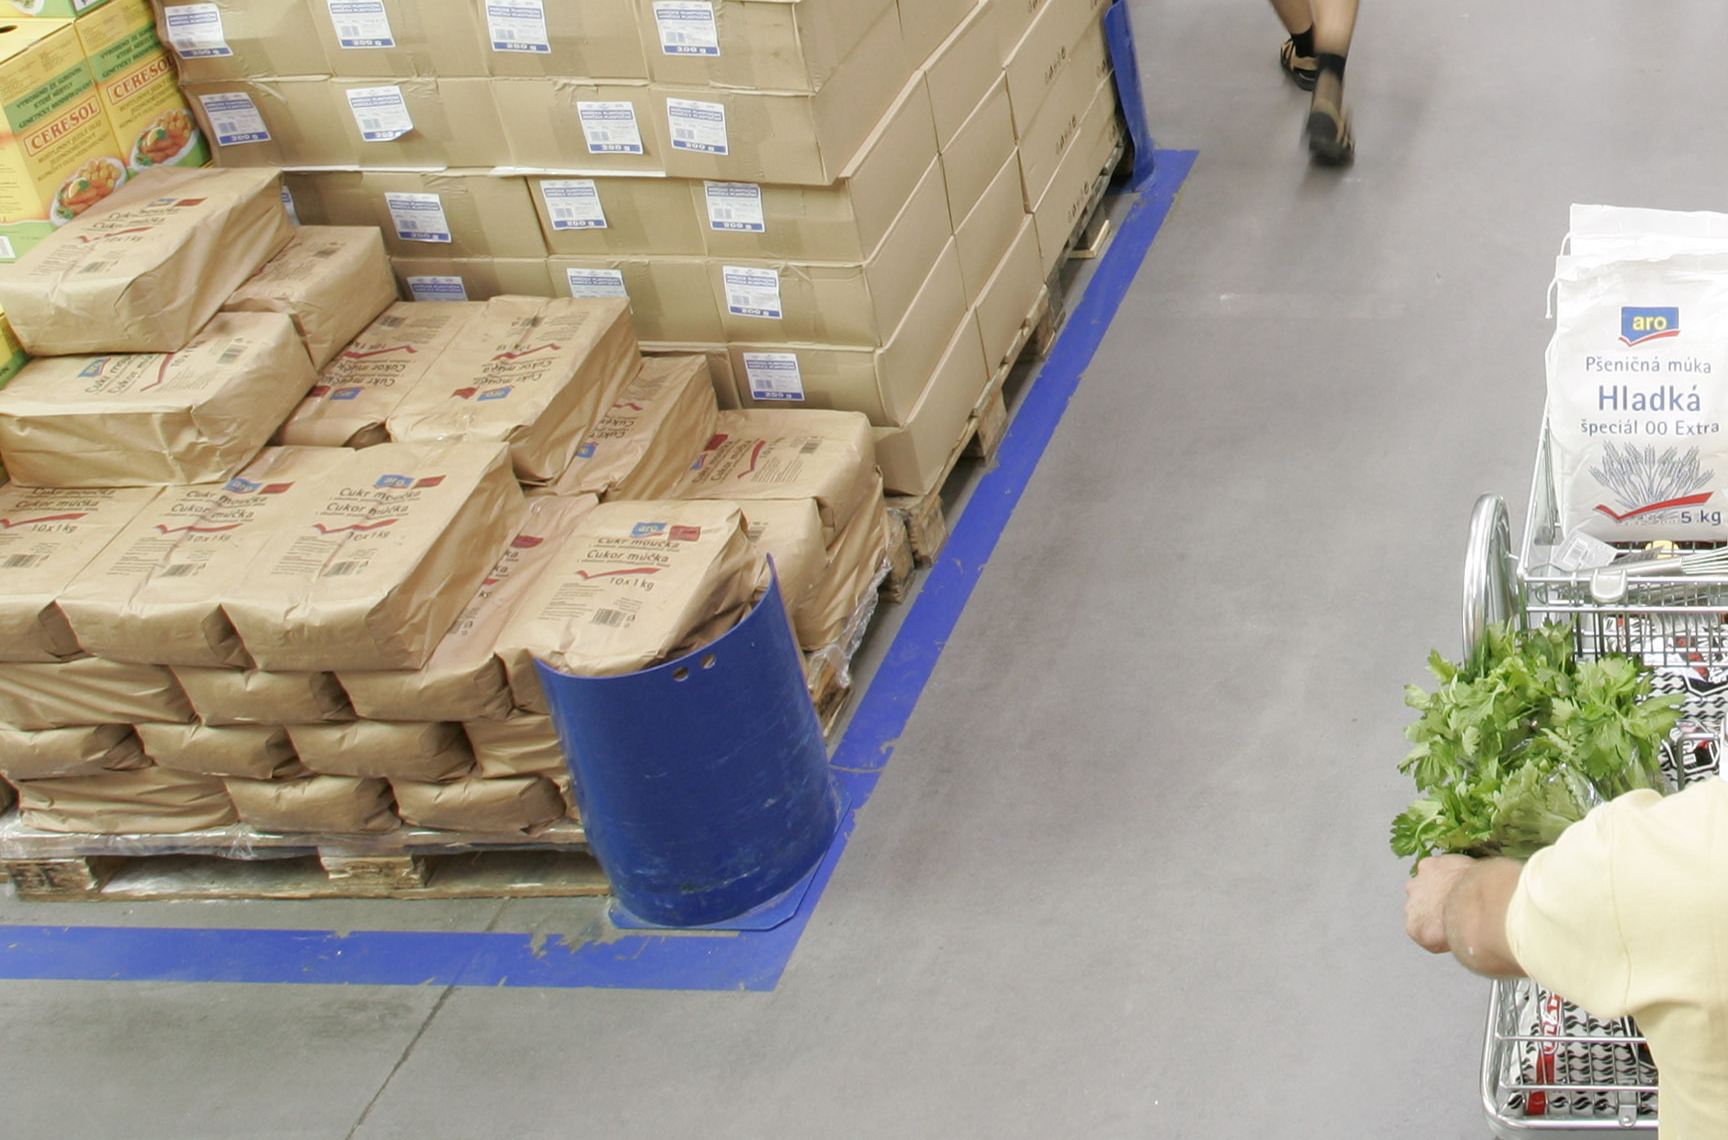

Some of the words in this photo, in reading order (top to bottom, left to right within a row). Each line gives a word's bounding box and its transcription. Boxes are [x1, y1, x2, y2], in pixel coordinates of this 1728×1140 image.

[30, 100, 99, 150] CERESOL
[1632, 315, 1668, 331] aro
[1585, 356, 1661, 373] Pšeničná
[1668, 358, 1712, 374] múka
[1598, 384, 1702, 412] Hladká
[1581, 419, 1638, 437] špeciál
[1675, 420, 1720, 436] Extra
[338, 487, 371, 498] Cukr
[16, 500, 55, 510] Cukor
[171, 503, 209, 514] Cukor
[326, 502, 366, 513] Cukor
[1681, 511, 1692, 524] 5
[1700, 509, 1722, 526] kg
[638, 524, 658, 534] aro
[586, 549, 624, 560] Cukor
[628, 551, 670, 563] múčka
